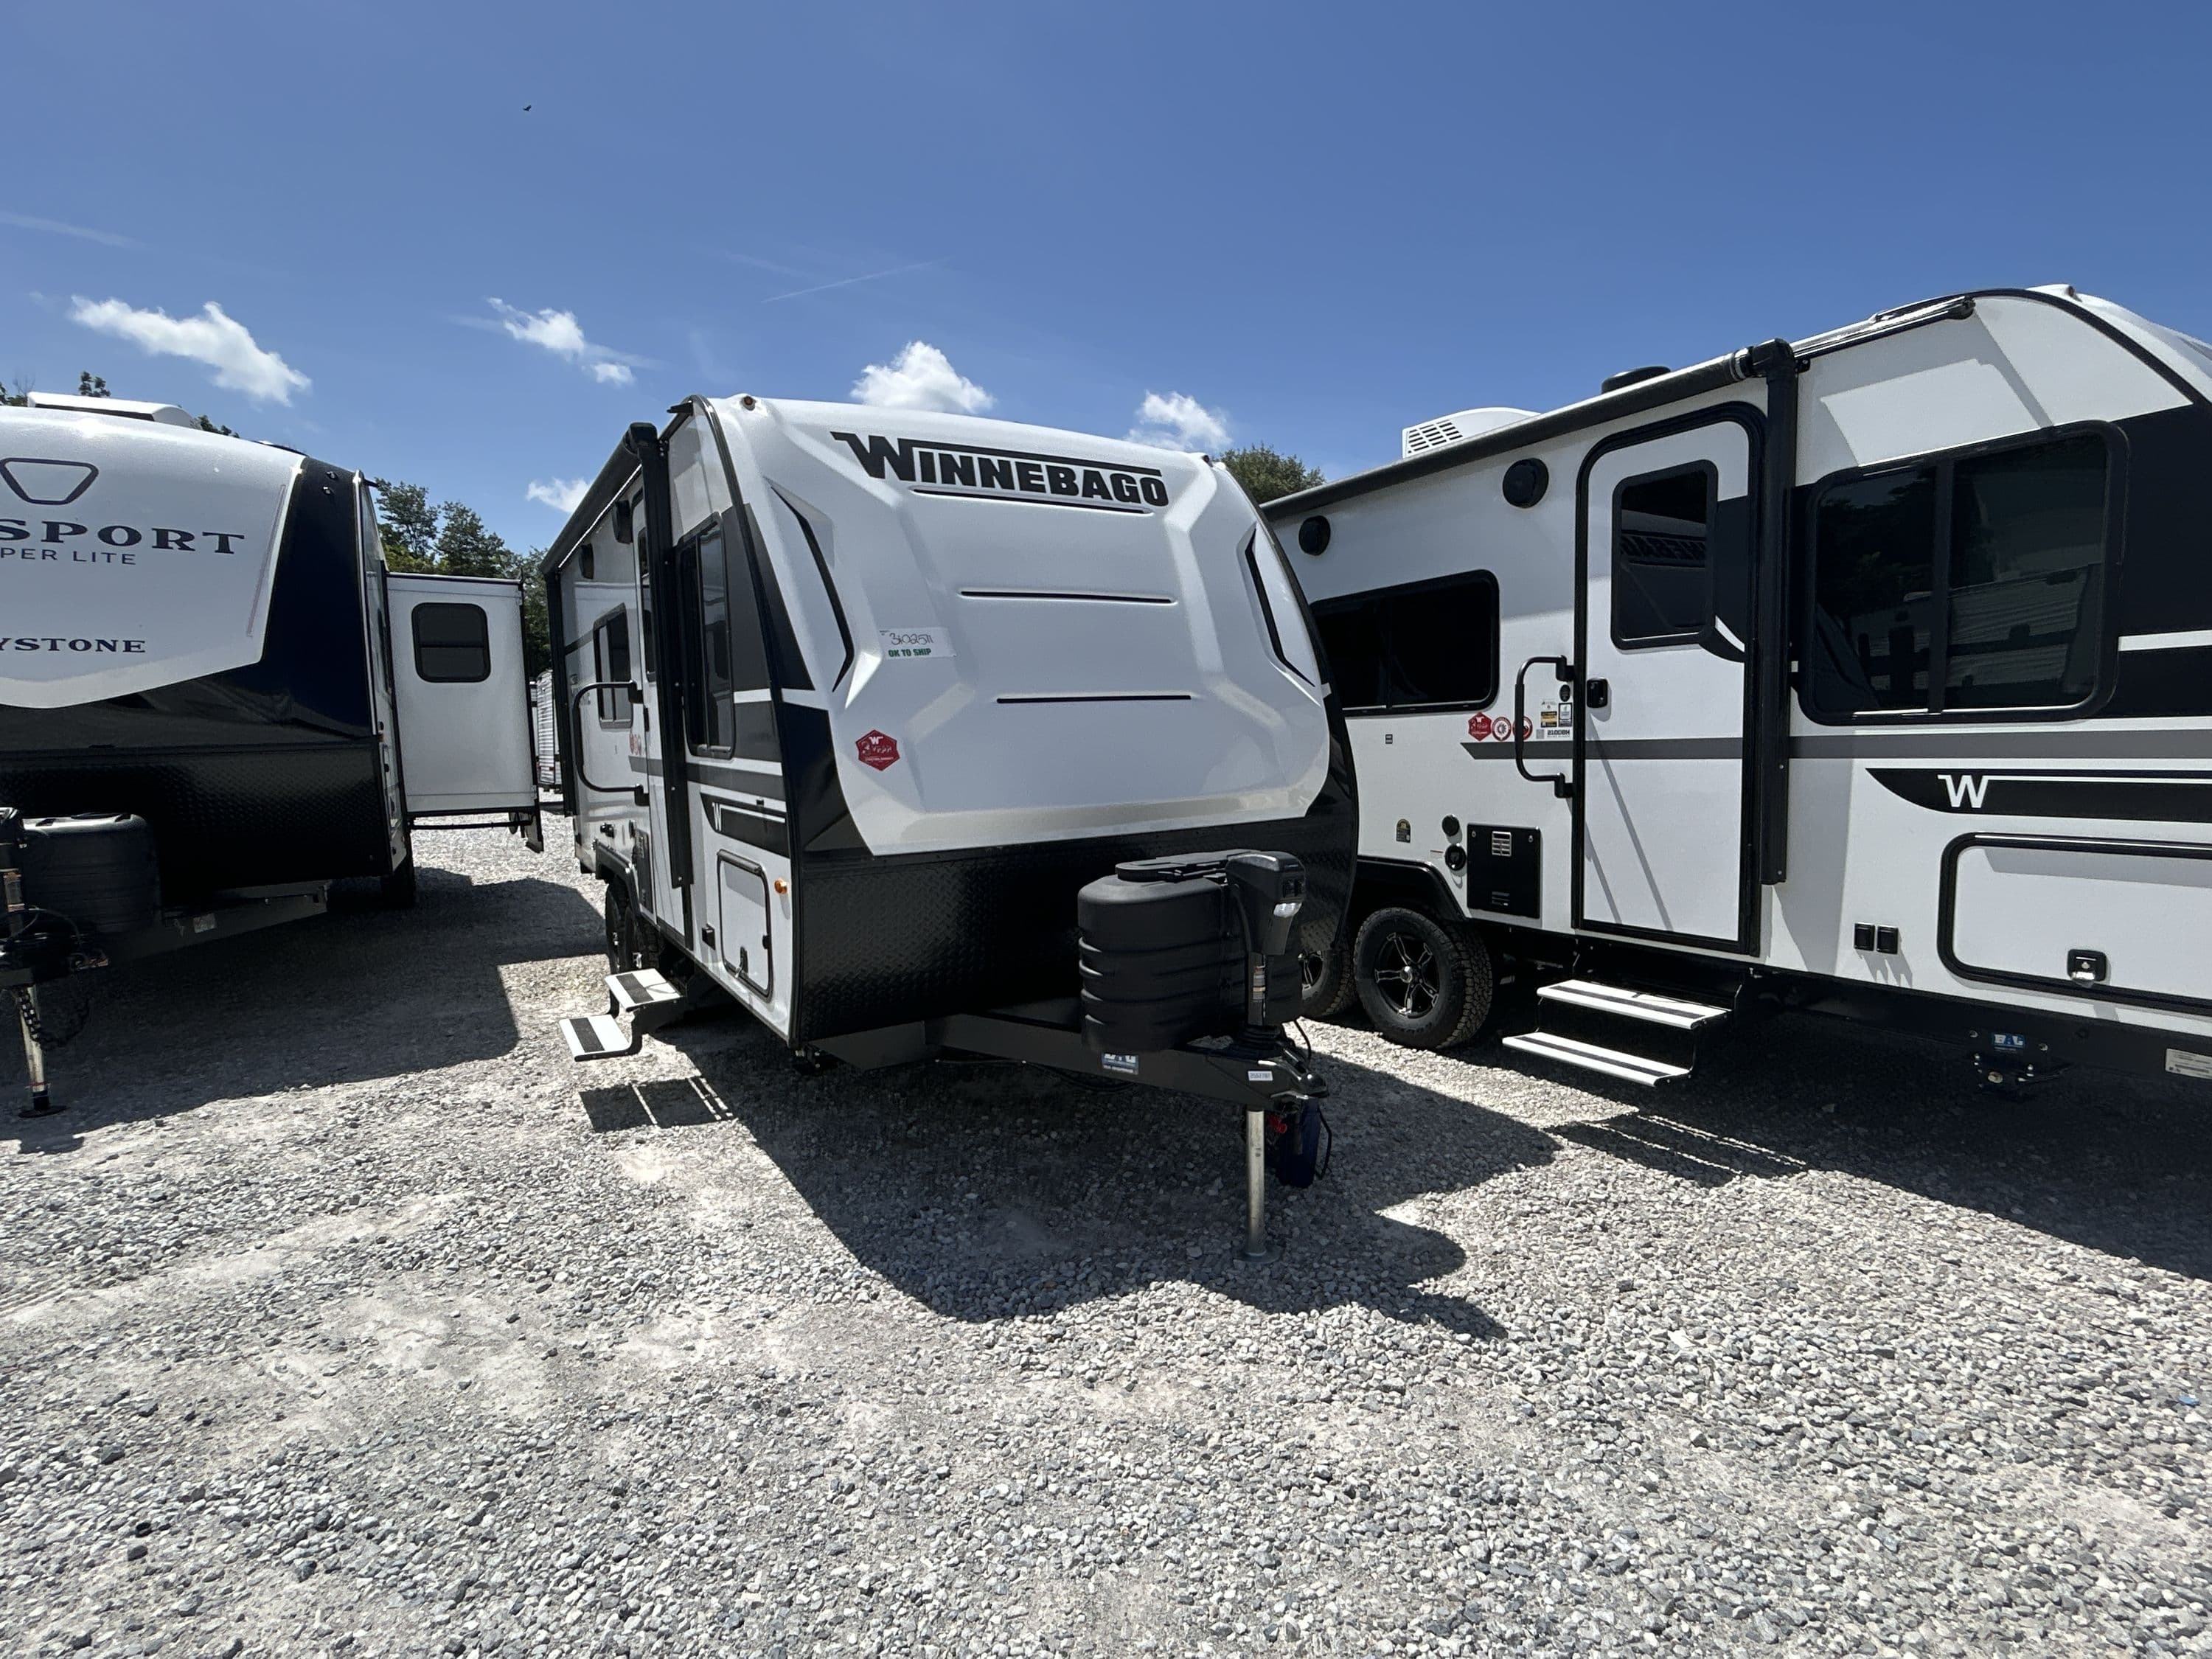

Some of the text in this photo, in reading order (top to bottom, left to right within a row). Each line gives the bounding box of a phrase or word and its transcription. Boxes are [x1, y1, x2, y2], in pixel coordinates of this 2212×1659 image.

[830, 431, 1169, 507] WINNEBAGO
[0, 518, 246, 554] SPORT
[1, 547, 136, 565] PER LITE
[888, 647, 932, 658] OK TO SHIP
[869, 736, 884, 745] W
[1937, 774, 1989, 808] W
